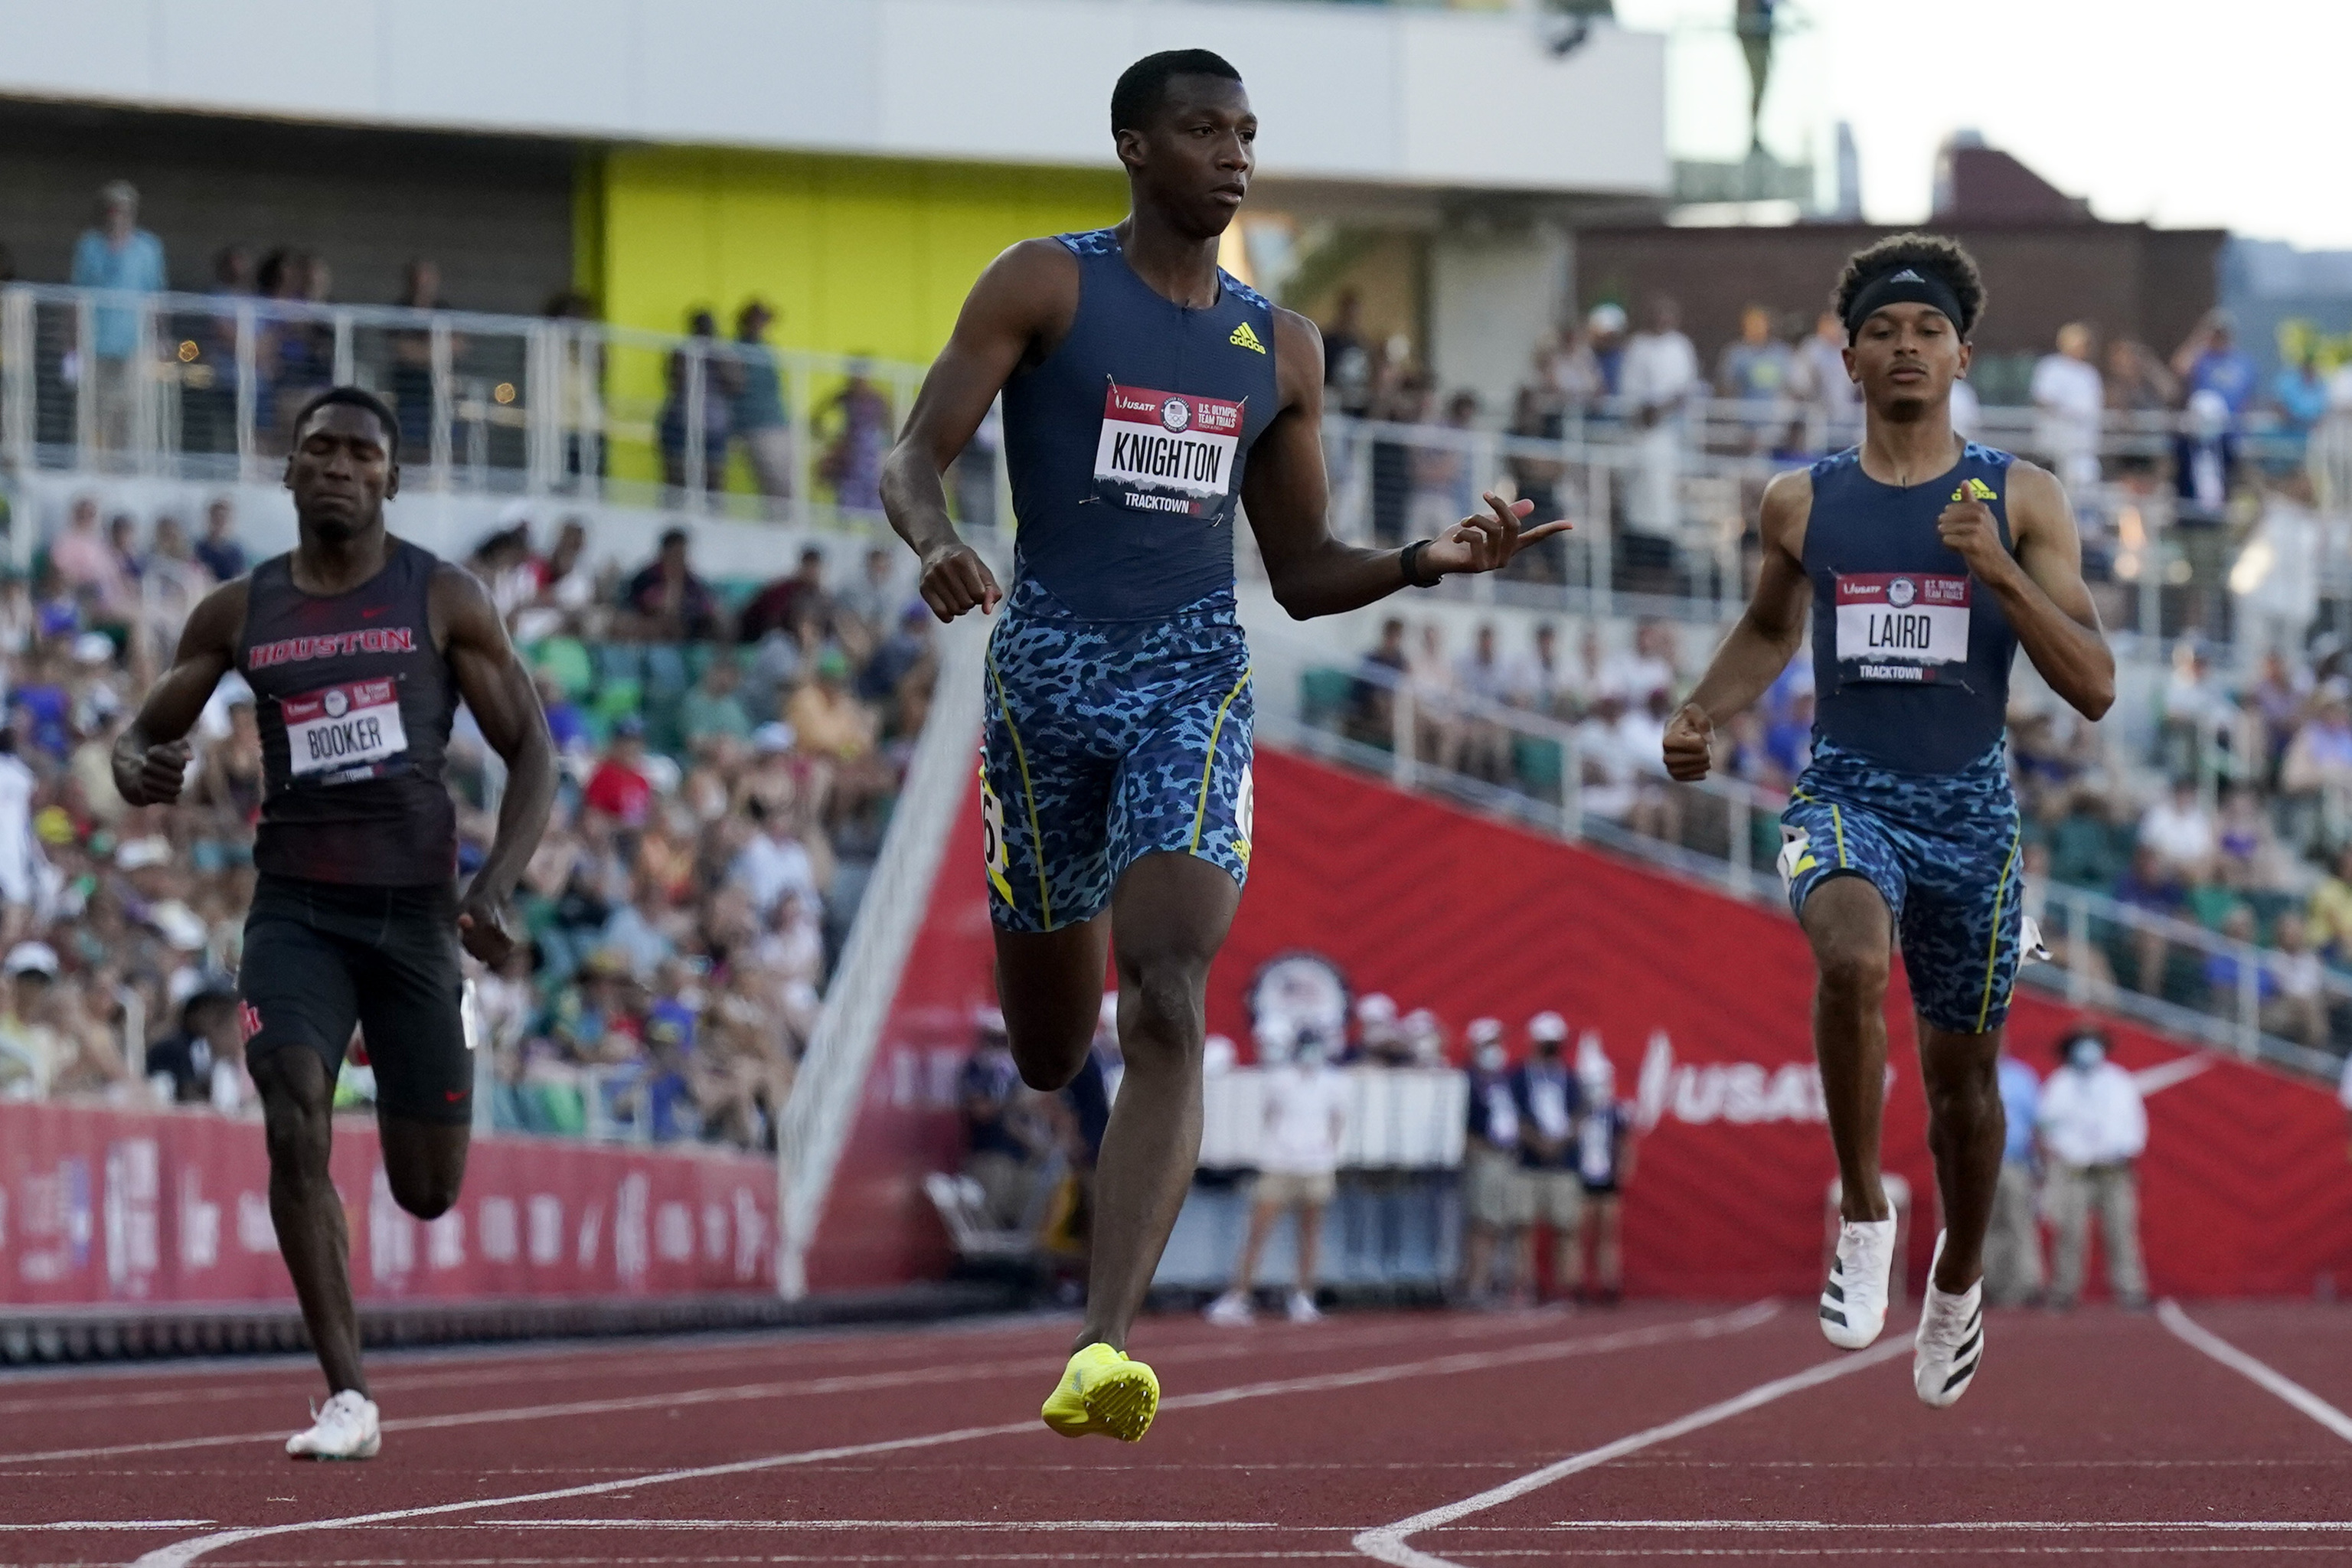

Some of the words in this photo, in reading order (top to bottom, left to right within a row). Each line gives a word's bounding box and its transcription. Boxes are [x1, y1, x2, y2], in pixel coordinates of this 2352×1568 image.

[1229, 335, 1266, 354] adidas
[1127, 401, 1156, 412] USATF
[1198, 403, 1210, 414] U.S.
[1211, 404, 1237, 418] OLYMPIC
[1198, 413, 1215, 425] TEAM
[1216, 416, 1236, 428] TRIALS
[1111, 432, 1223, 483] KNIGHTON
[1869, 614, 1931, 648] LAIRD
[249, 626, 413, 671] HOUSTON
[307, 716, 383, 760] BOOKER
